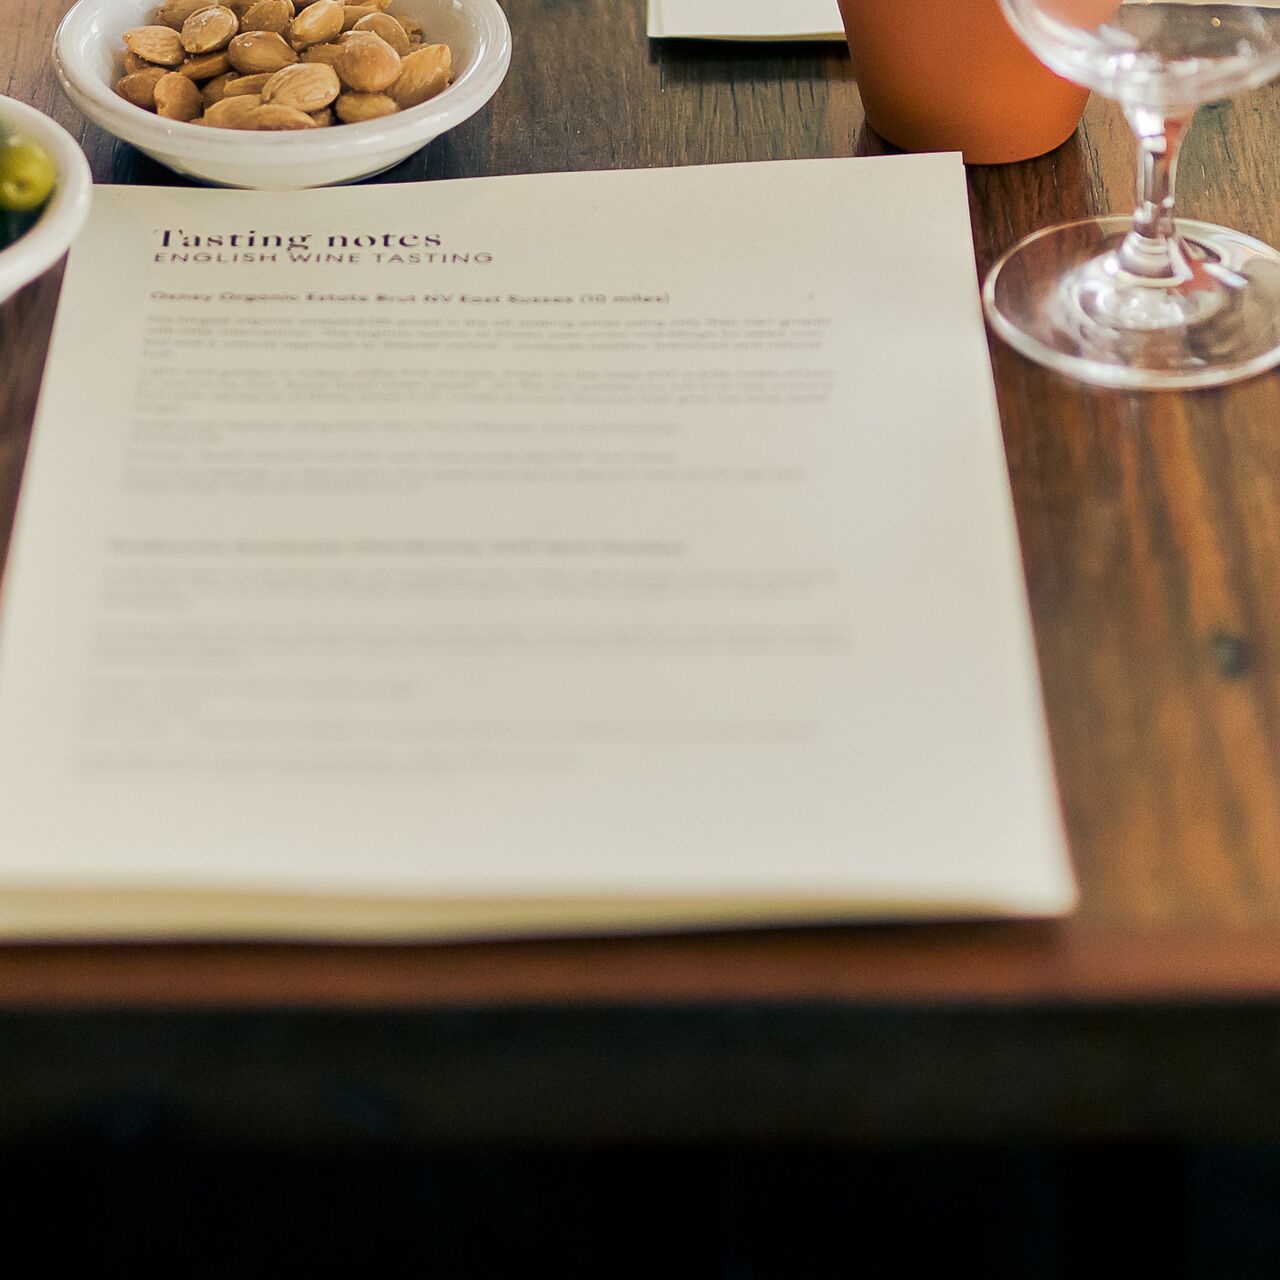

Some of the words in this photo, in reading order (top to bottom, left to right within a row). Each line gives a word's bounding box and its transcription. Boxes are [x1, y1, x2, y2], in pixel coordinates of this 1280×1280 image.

[153, 229, 312, 251] Tasting
[327, 233, 442, 248] notes
[153, 253, 277, 264] ENGLISH
[289, 253, 360, 264] WINE
[373, 253, 493, 264] TASTING
